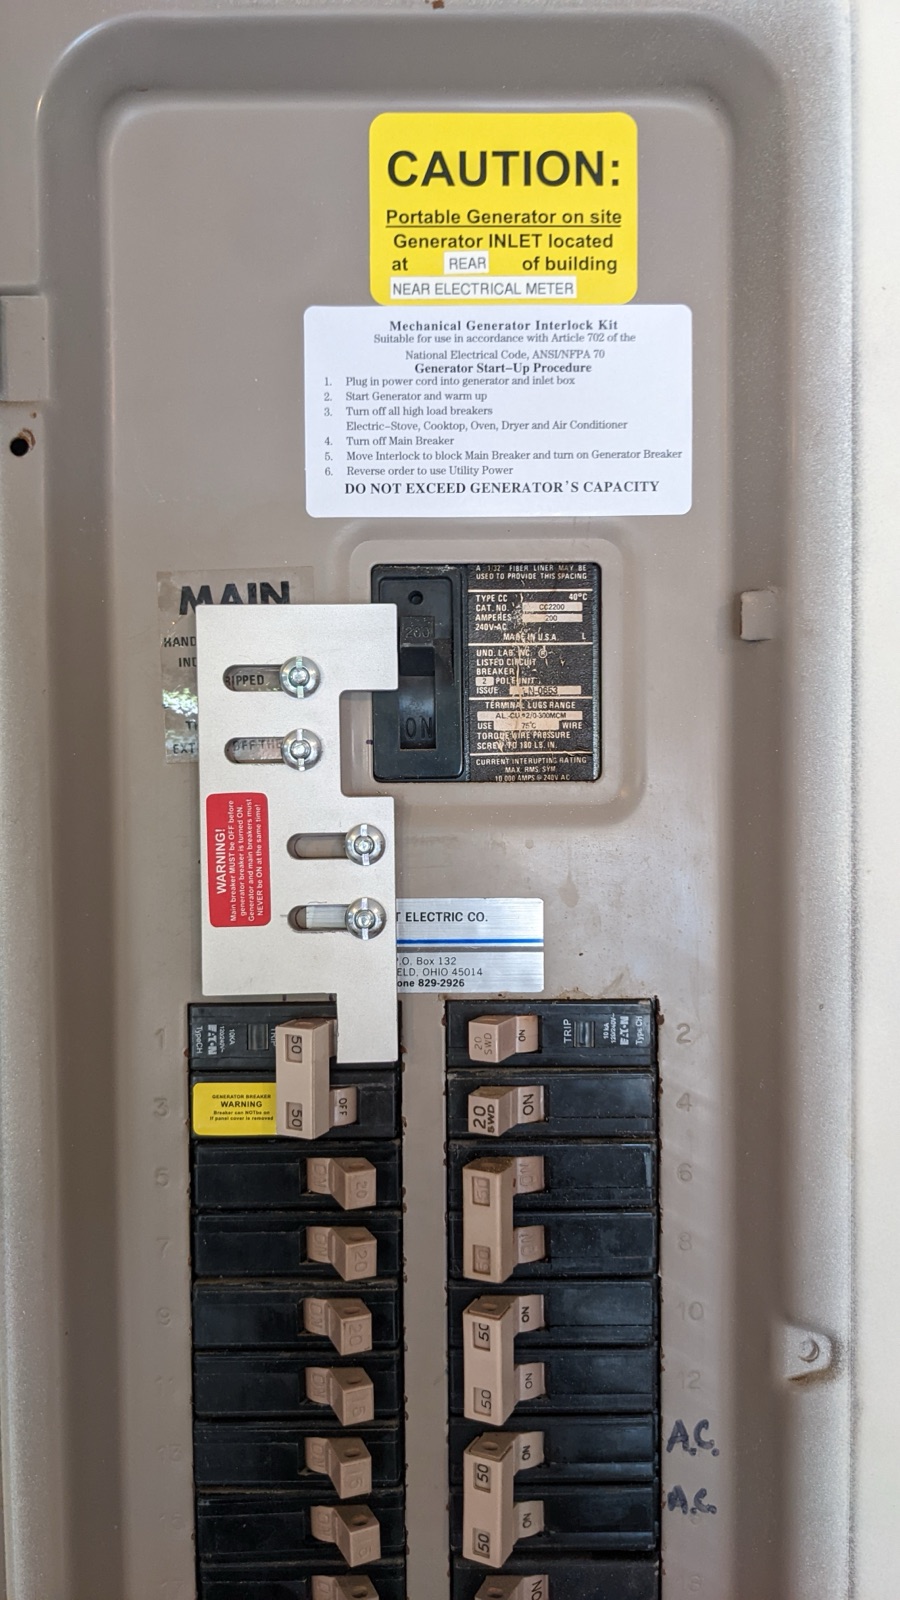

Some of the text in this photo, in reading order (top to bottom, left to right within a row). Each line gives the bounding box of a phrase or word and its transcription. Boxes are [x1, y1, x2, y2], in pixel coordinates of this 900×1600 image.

[387, 150, 619, 187] CAUTION:
[386, 209, 622, 224] Portable Generator on site
[393, 233, 613, 248] Generator INLET located
[392, 256, 617, 275] at REAR of building
[393, 282, 574, 296] NEAR ELECTRICAL METER
[390, 320, 618, 332] Mechanical Generator Interlock Kit
[415, 363, 474, 374] Generator
[534, 362, 592, 373] Procedure
[325, 376, 576, 389] 1. Plug in power cord into generator and inlet box
[324, 406, 494, 418] 3. Turn off all high load breakers
[424, 421, 469, 433] Cooktop,
[471, 421, 500, 432] Oven,
[502, 421, 530, 433] Dryer
[532, 421, 551, 430] and
[552, 421, 568, 430] Air
[570, 420, 629, 430] Conditioner
[325, 436, 456, 446] 4. Turn off Main Breaker
[325, 452, 334, 462] 5.
[347, 452, 374, 462] Move
[376, 451, 421, 462] Interlock
[423, 452, 434, 461] to
[436, 451, 463, 461] block
[465, 451, 490, 461] Main
[492, 451, 532, 461] Breaker
[533, 450, 552, 460] and
[554, 452, 575, 460] turn
[592, 450, 642, 460] Generator
[644, 450, 684, 460] Breaker
[325, 467, 334, 477] 6.
[347, 466, 386, 476] Reverse
[388, 466, 416, 476] order
[418, 467, 428, 476] to
[449, 466, 480, 477] Utility
[482, 466, 514, 475] Power
[345, 483, 366, 495] DO
[370, 483, 402, 495] NOT
[406, 483, 466, 494] EXCEED
[583, 481, 659, 493] CAPACITY
[180, 581, 290, 615] MAIN
[406, 717, 432, 739] ON
[229, 842, 236, 852] be
[214, 828, 227, 895] WARNING!
[256, 867, 263, 879] ON
[257, 880, 264, 889] be
[406, 912, 463, 922] ELECTRIC
[467, 911, 488, 922] CO.
[397, 957, 456, 965] .O. Box 132
[422, 968, 448, 976] OHIO
[452, 968, 482, 976] 45014
[418, 979, 464, 987] 829-2926
[518, 1030, 526, 1042] ON
[563, 1019, 571, 1043] TRIP
[636, 1016, 644, 1045] Type CH
[676, 1024, 691, 1044] 2
[291, 1036, 302, 1054] 50
[474, 1036, 482, 1050] 20
[484, 1033, 492, 1055] SWD
[339, 1098, 347, 1116] OFF
[523, 1094, 534, 1115] ON
[676, 1093, 692, 1112] 4
[292, 1109, 302, 1127] 50
[473, 1106, 486, 1129] 20
[677, 1163, 692, 1182] 6
[522, 1306, 530, 1323] ON
[525, 1373, 532, 1389] ON
[481, 1390, 491, 1409] 50
[666, 1419, 720, 1457] A.C.
[522, 1445, 530, 1460] ON
[477, 1464, 489, 1482] 50
[667, 1485, 717, 1514] A.C.
[523, 1513, 531, 1528] ON
[478, 1534, 489, 1553] 50
